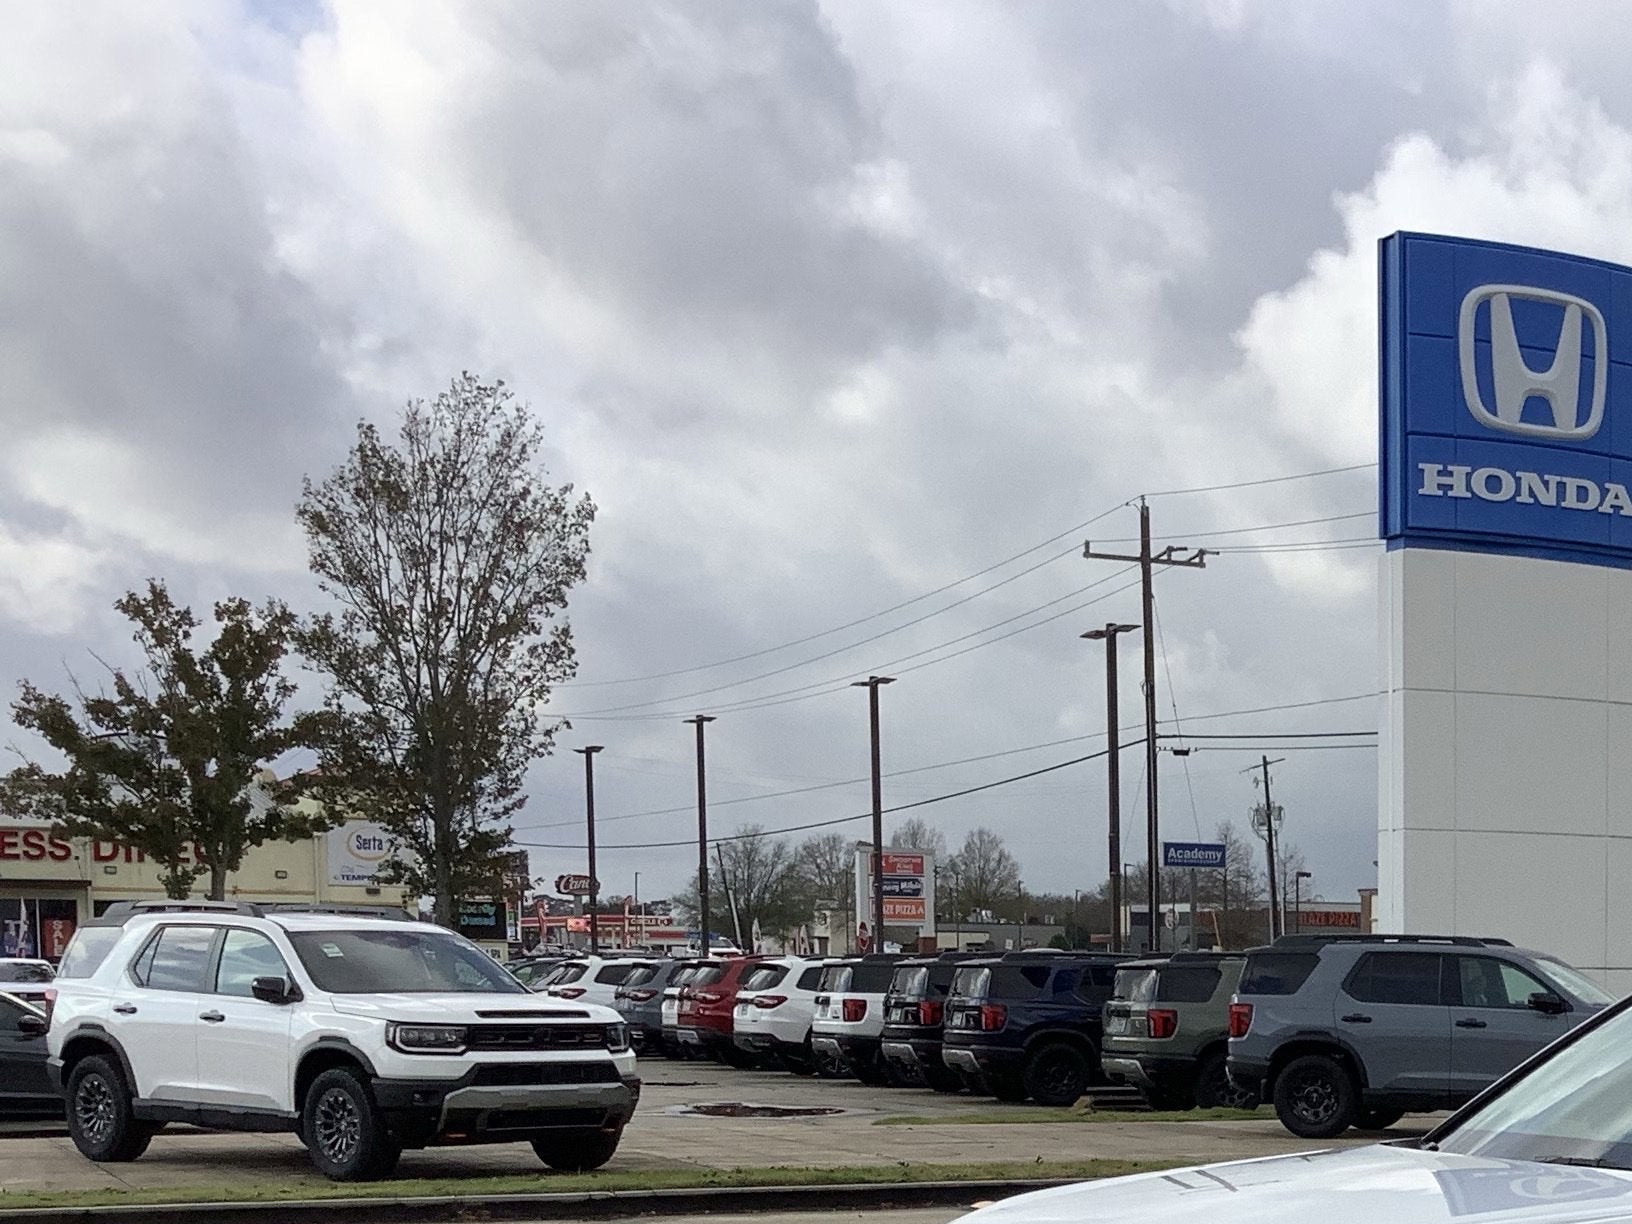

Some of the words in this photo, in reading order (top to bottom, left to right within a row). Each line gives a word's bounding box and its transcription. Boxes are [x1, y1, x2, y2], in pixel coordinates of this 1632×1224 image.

[355, 834, 384, 851] Serta
[1167, 847, 1223, 863] Academy
[895, 904, 916, 915] PIZZA
